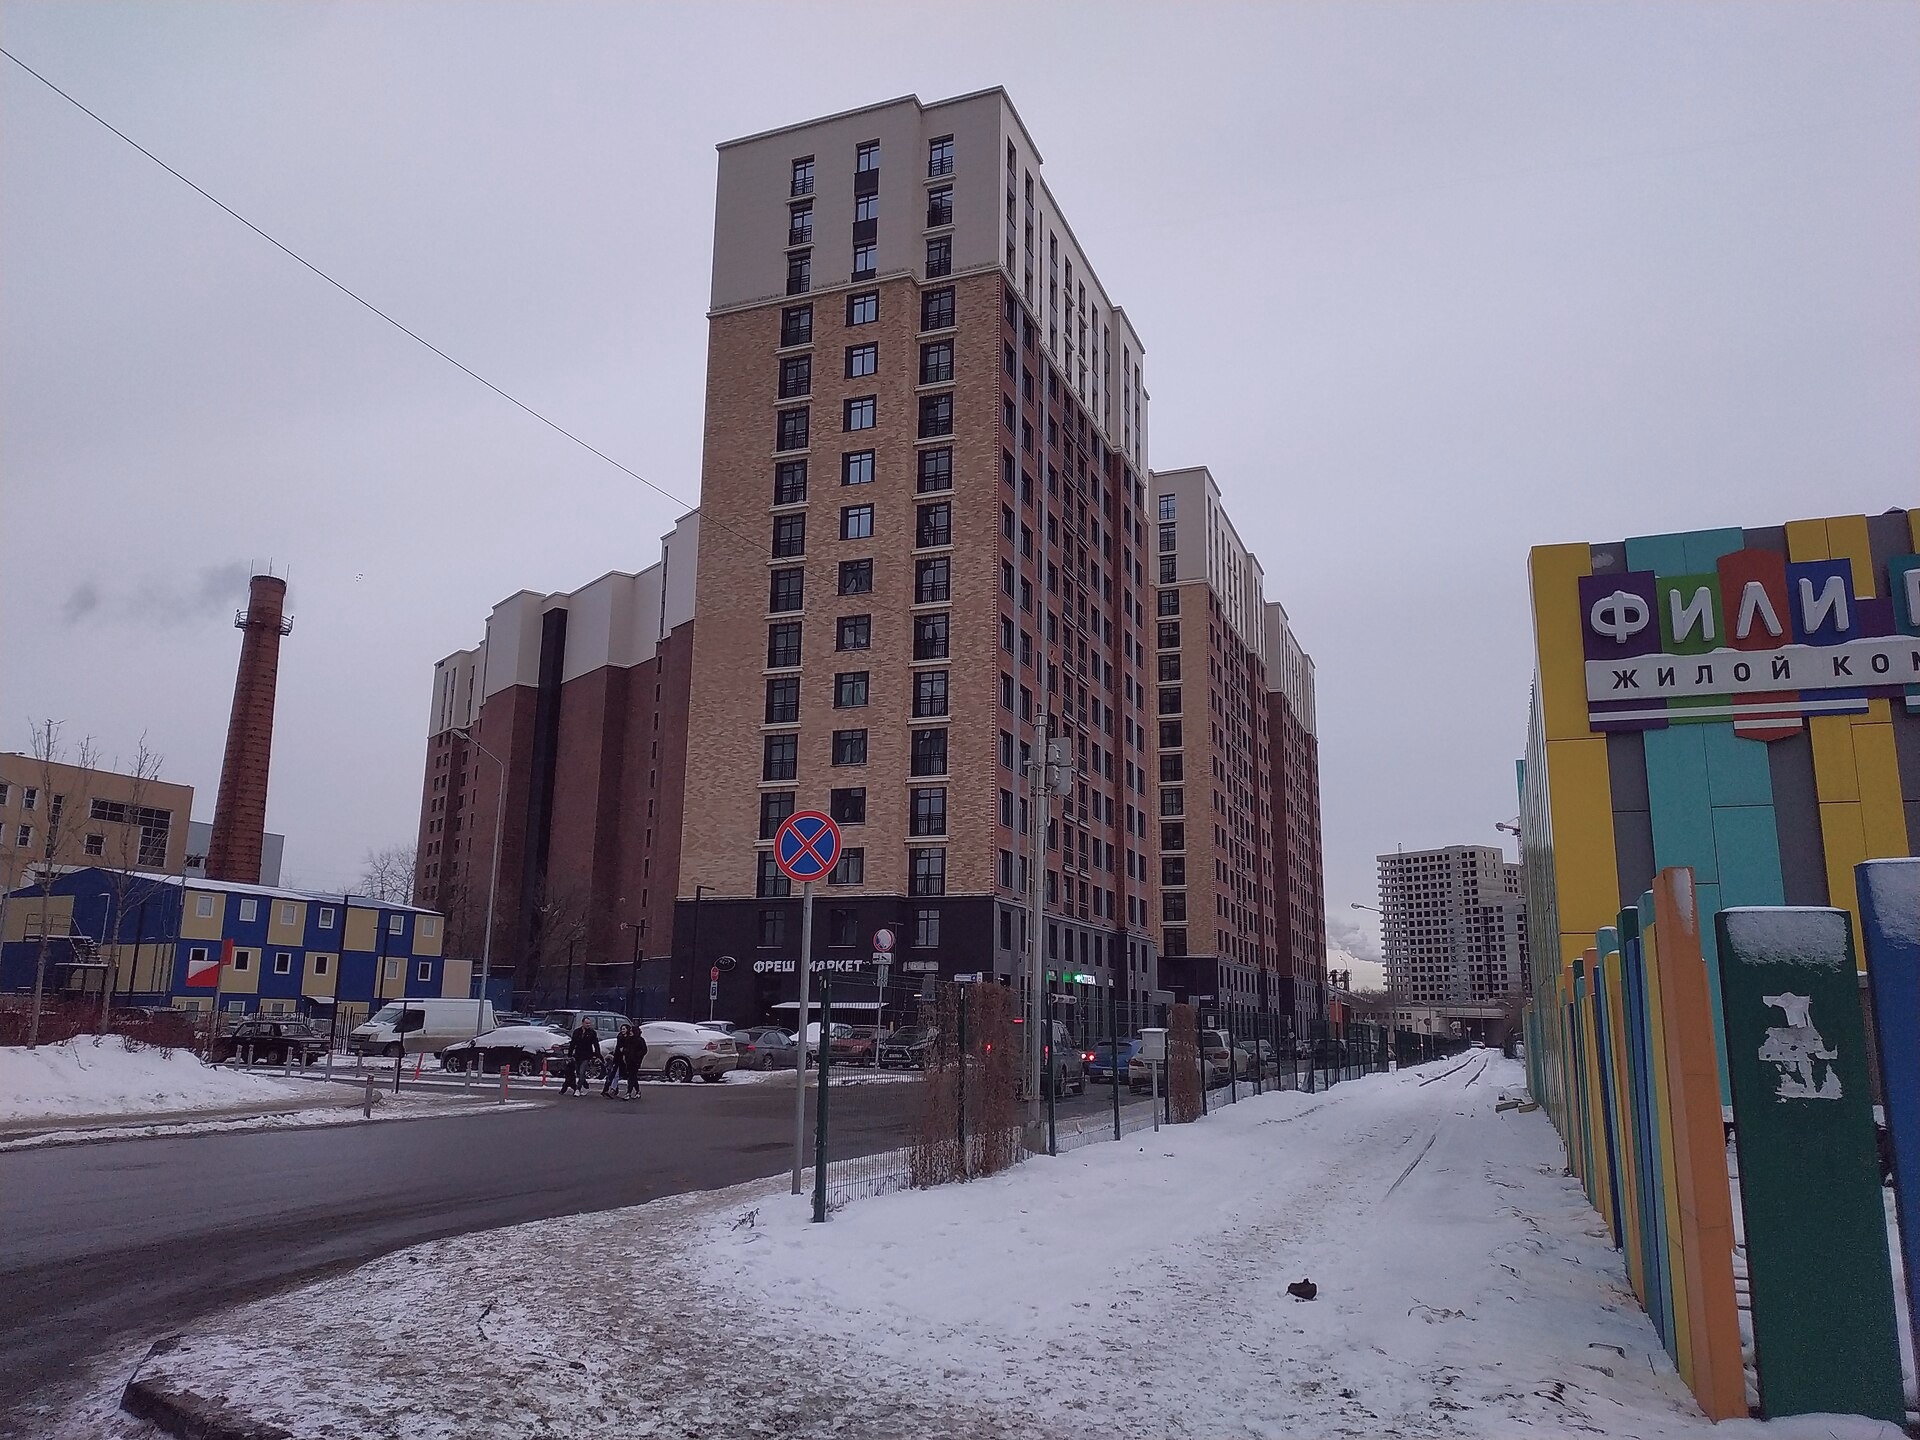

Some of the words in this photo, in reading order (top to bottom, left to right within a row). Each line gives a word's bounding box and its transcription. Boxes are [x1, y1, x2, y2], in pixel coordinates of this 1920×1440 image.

[1590, 575, 1850, 644] ФИЛИ
[1612, 656, 1791, 689] ЖИЛОЙ
[753, 960, 795, 973] ФРЕШ
